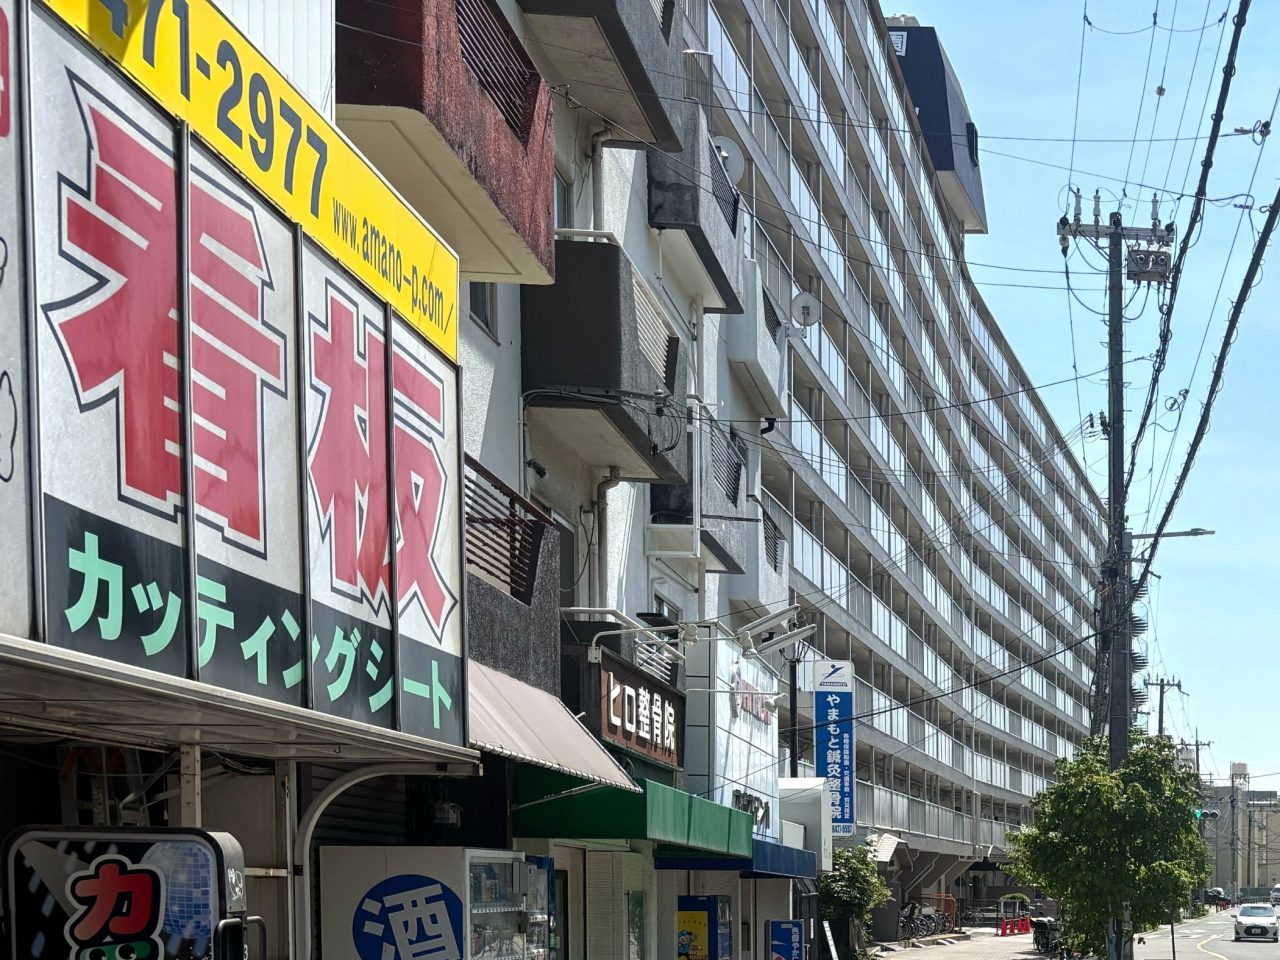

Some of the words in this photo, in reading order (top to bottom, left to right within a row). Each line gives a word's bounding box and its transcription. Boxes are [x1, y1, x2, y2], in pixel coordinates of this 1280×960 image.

[332, 196, 454, 335] www.amano-p.com/
[41, 66, 458, 645] 看板
[65, 531, 452, 729] カッティングシート
[608, 671, 675, 750] ヒロ整骨院
